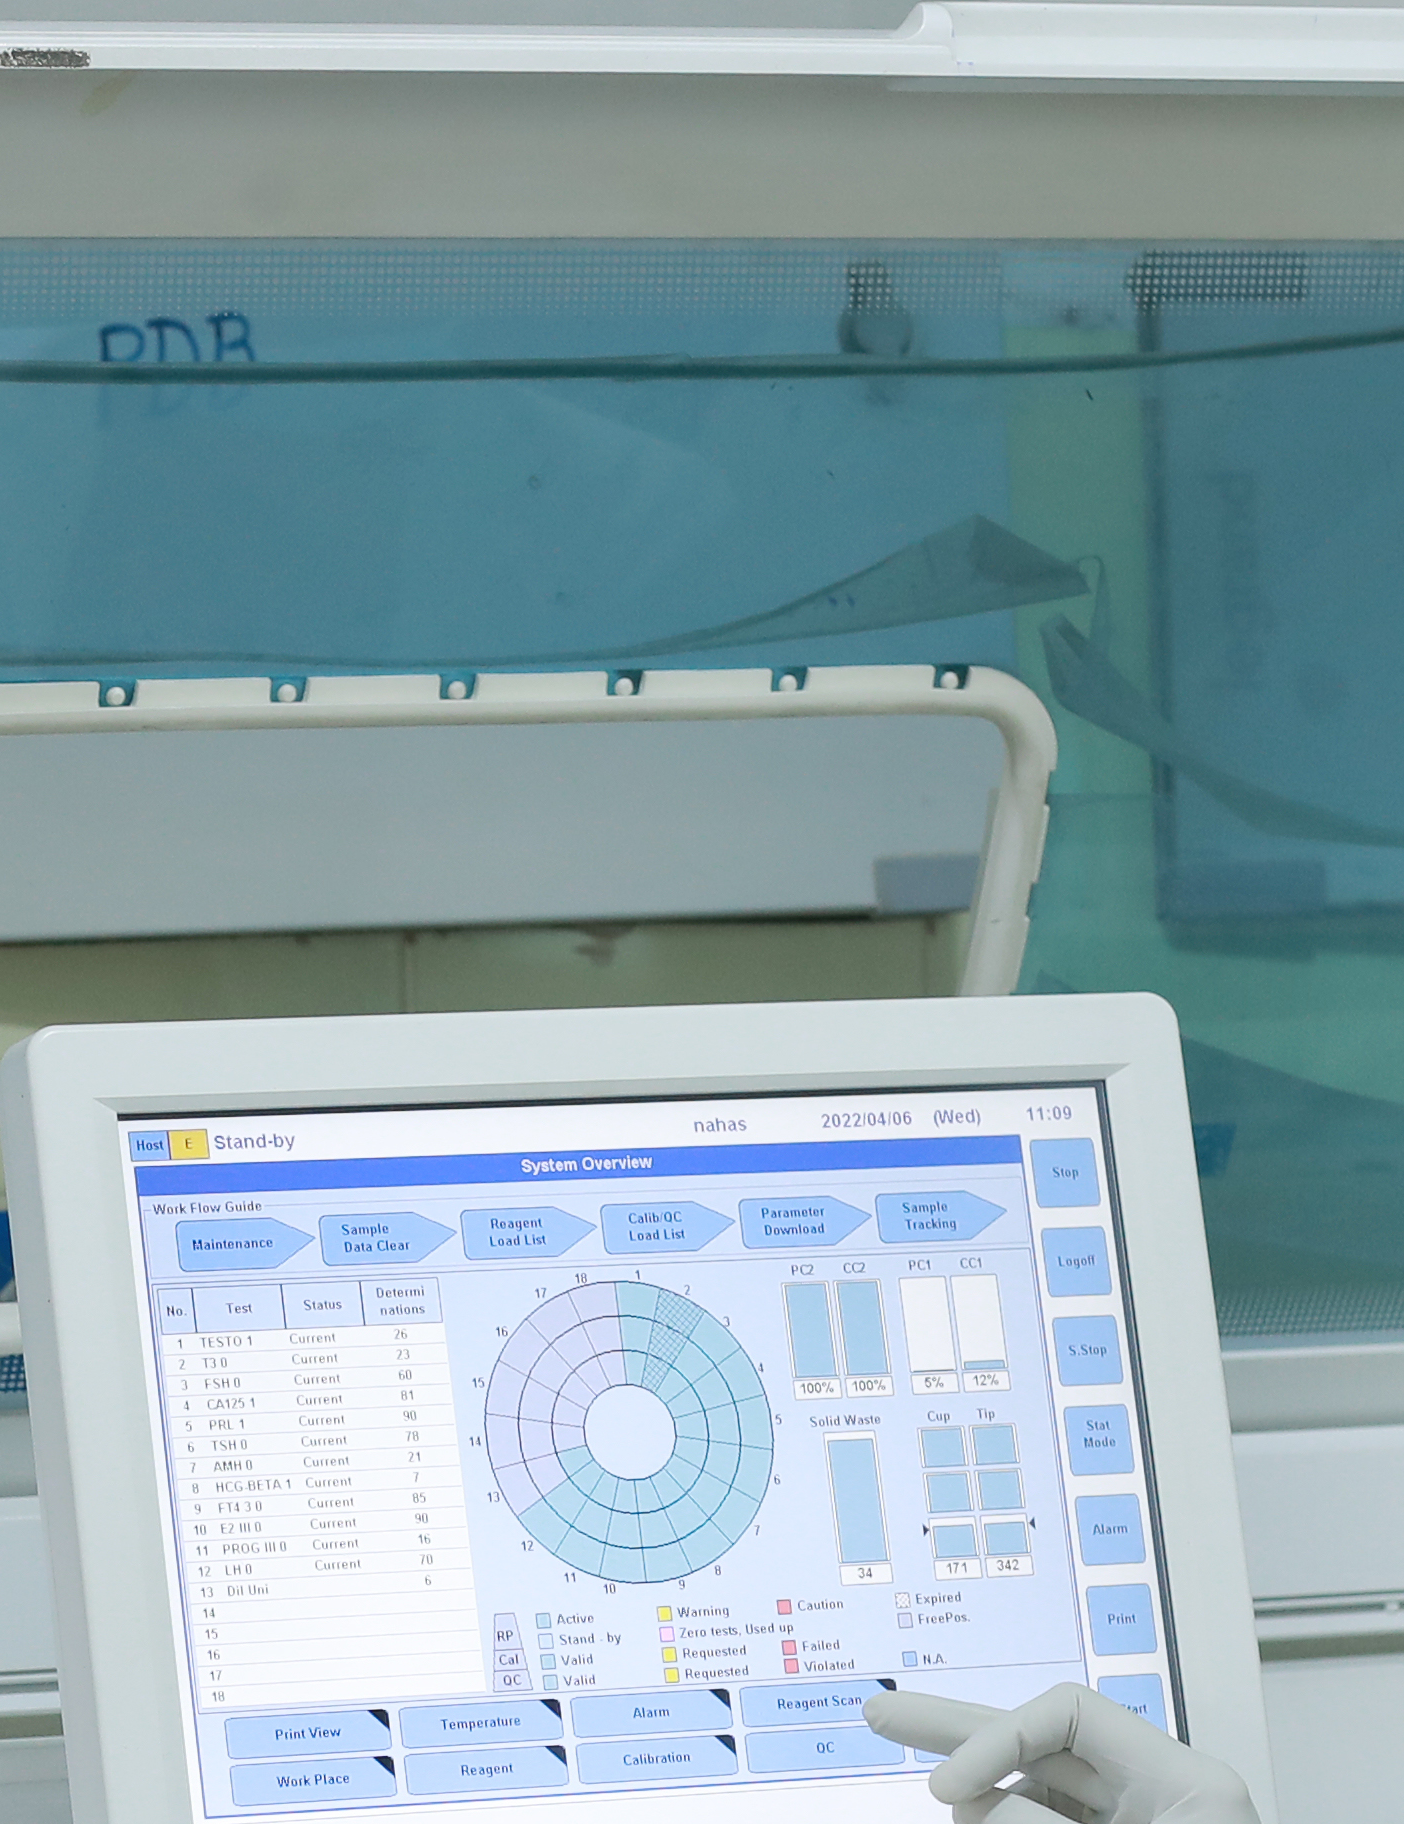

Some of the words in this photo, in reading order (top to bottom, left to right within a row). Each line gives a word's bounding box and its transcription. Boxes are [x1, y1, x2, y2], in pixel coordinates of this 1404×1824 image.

[821, 1110, 913, 1129] 2022/04/06
[933, 1108, 982, 1128] (Wed)
[1026, 1105, 1072, 1121] 11:09
[693, 1117, 748, 1133] nahas
[136, 1139, 165, 1152] Host
[213, 1133, 295, 1152] Stand-by
[521, 1158, 577, 1175] System
[582, 1155, 652, 1170] Overview
[1052, 1166, 1079, 1181] Stop
[152, 1202, 187, 1216] Work
[189, 1202, 221, 1214] Flow
[225, 1200, 262, 1213] Guide
[761, 1206, 825, 1220] Parameter
[901, 1200, 948, 1216] Sample
[628, 1210, 683, 1225] Calib/QC
[341, 1222, 389, 1238] Sample
[490, 1217, 543, 1232] Reagent
[763, 1222, 825, 1237] Download
[904, 1217, 957, 1232] Tracking
[489, 1234, 521, 1248] Load
[524, 1233, 547, 1246] List
[629, 1228, 660, 1242] Load
[663, 1228, 686, 1241] List
[191, 1238, 273, 1252] Maintenance
[343, 1241, 373, 1253] Data
[376, 1239, 410, 1252] Clear
[842, 1261, 866, 1274] CC2
[908, 1258, 931, 1271] PC1
[959, 1256, 983, 1270] CC1
[1057, 1254, 1095, 1270] Logoff
[790, 1263, 814, 1277] PC2
[375, 1285, 425, 1299] Determi
[166, 1306, 187, 1317] No.
[225, 1302, 253, 1315] Test
[303, 1299, 343, 1311] Status
[380, 1303, 426, 1316] nations
[289, 1332, 336, 1345] Current
[394, 1328, 408, 1340] 26
[200, 1335, 242, 1349] TESTO
[247, 1335, 253, 1346] 1
[396, 1348, 411, 1361] 23
[1068, 1343, 1108, 1358] S.Stop
[201, 1357, 217, 1369] T3
[220, 1356, 228, 1368] 0
[291, 1353, 338, 1365] Current
[293, 1374, 340, 1386] Current
[398, 1369, 413, 1381] 60
[972, 1373, 1000, 1387] 12%
[204, 1377, 230, 1390] FSH
[233, 1377, 241, 1389] 0
[800, 1381, 835, 1395] 100%
[852, 1379, 887, 1392] 100%
[924, 1376, 945, 1389] 5%
[296, 1394, 343, 1406] Current
[400, 1389, 414, 1401] 81
[206, 1397, 245, 1411] CA125
[249, 1397, 256, 1408] 1
[298, 1414, 345, 1427] Current
[402, 1410, 417, 1422] 90
[809, 1414, 841, 1428] Solid
[843, 1414, 881, 1426] Waste
[927, 1410, 951, 1425] Cup
[976, 1407, 996, 1423] Tip
[209, 1419, 234, 1430] PRL
[239, 1418, 245, 1429] 1
[1086, 1419, 1111, 1432] Stat
[300, 1435, 347, 1448] Current
[405, 1430, 420, 1442] 78
[1083, 1435, 1116, 1449] Mode
[211, 1439, 237, 1452] TSH
[240, 1438, 248, 1451] 0
[303, 1456, 350, 1468] Current
[408, 1451, 421, 1463] 21
[213, 1460, 242, 1472] AMH
[245, 1459, 253, 1471] 0
[305, 1476, 352, 1489] Current
[412, 1471, 420, 1483] 7
[215, 1478, 282, 1493] HCG-BETA
[285, 1478, 292, 1490] 1
[307, 1497, 354, 1509] Current
[412, 1492, 427, 1504] 85
[217, 1501, 240, 1514] FT4
[244, 1500, 252, 1513] 3
[255, 1501, 263, 1512] 0
[309, 1518, 356, 1530] Current
[414, 1513, 429, 1524] 90
[220, 1522, 235, 1535] E2
[239, 1522, 251, 1533] III
[254, 1521, 262, 1533] 0
[1092, 1523, 1129, 1536] Alarm
[312, 1538, 359, 1550] Current
[418, 1533, 431, 1545] 16
[222, 1542, 260, 1555] PROG
[264, 1541, 276, 1553] III
[279, 1541, 287, 1552] 0
[314, 1559, 361, 1572] Current
[420, 1554, 434, 1565] 70
[996, 1558, 1020, 1572] 342
[224, 1564, 242, 1576] LH
[245, 1563, 253, 1575] 0
[857, 1567, 873, 1579] 34
[946, 1561, 968, 1574] 171
[424, 1574, 432, 1586] 6
[227, 1585, 244, 1597] Dil
[247, 1583, 269, 1596] Uni
[916, 1592, 961, 1604] Expired
[676, 1605, 730, 1619] Warning
[797, 1599, 844, 1612] Caution
[557, 1613, 595, 1625] Active
[1107, 1612, 1137, 1626] Print
[496, 1629, 514, 1642] RP
[679, 1627, 707, 1639] Zero
[710, 1626, 742, 1637] tests,
[745, 1622, 775, 1635] Used
[779, 1624, 794, 1636] up
[802, 1638, 840, 1652] Failed
[682, 1644, 747, 1661] Requested
[922, 1653, 945, 1665] N.A.
[498, 1653, 519, 1666] Cal
[560, 1653, 594, 1666] Valid
[803, 1658, 855, 1673] Violated
[684, 1664, 750, 1682] Requested
[502, 1673, 522, 1687] QC
[562, 1674, 596, 1687] Valid
[777, 1696, 829, 1712] Reagent
[831, 1694, 862, 1707] Scan
[1120, 1703, 1148, 1715] tart
[633, 1706, 670, 1719] Alarm
[440, 1716, 521, 1733] Temperature
[275, 1728, 307, 1741] Print
[308, 1726, 342, 1739] View
[816, 1741, 835, 1754] QC
[623, 1751, 691, 1766] Calibration
[460, 1762, 514, 1778] Reagent
[275, 1774, 311, 1789] Work
[314, 1773, 350, 1786] Place
